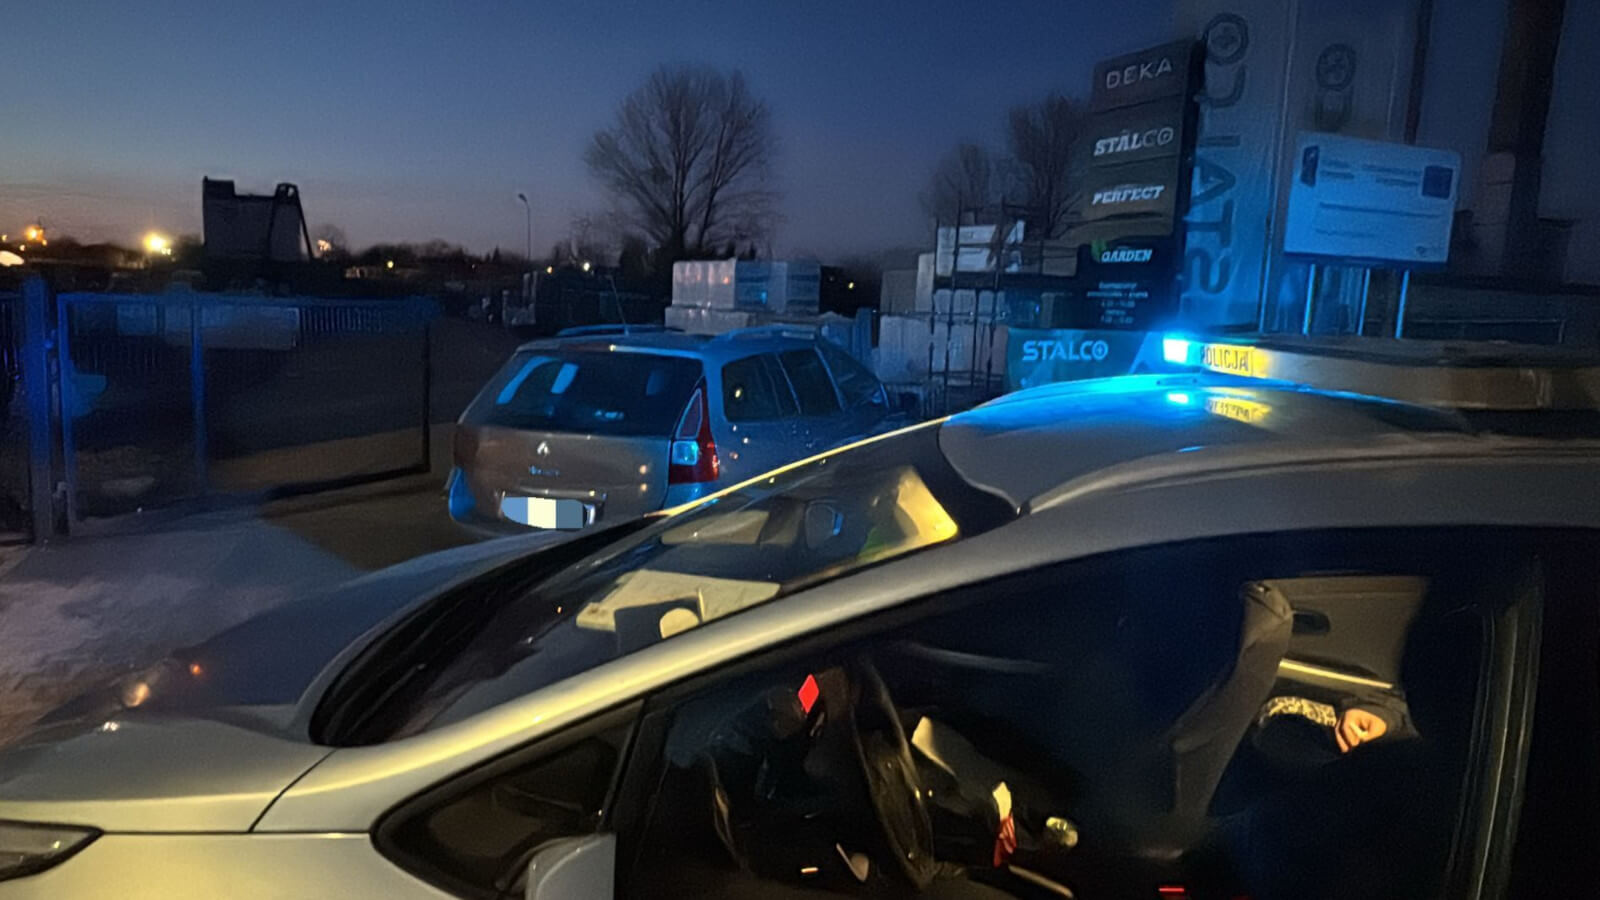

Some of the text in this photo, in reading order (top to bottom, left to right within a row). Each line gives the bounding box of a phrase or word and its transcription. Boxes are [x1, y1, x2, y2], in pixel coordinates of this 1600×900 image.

[1106, 58, 1172, 89] DEKA
[1092, 185, 1165, 205] PERFECT
[1101, 249, 1153, 263] GARDEN
[1022, 340, 1109, 361] STALCO
